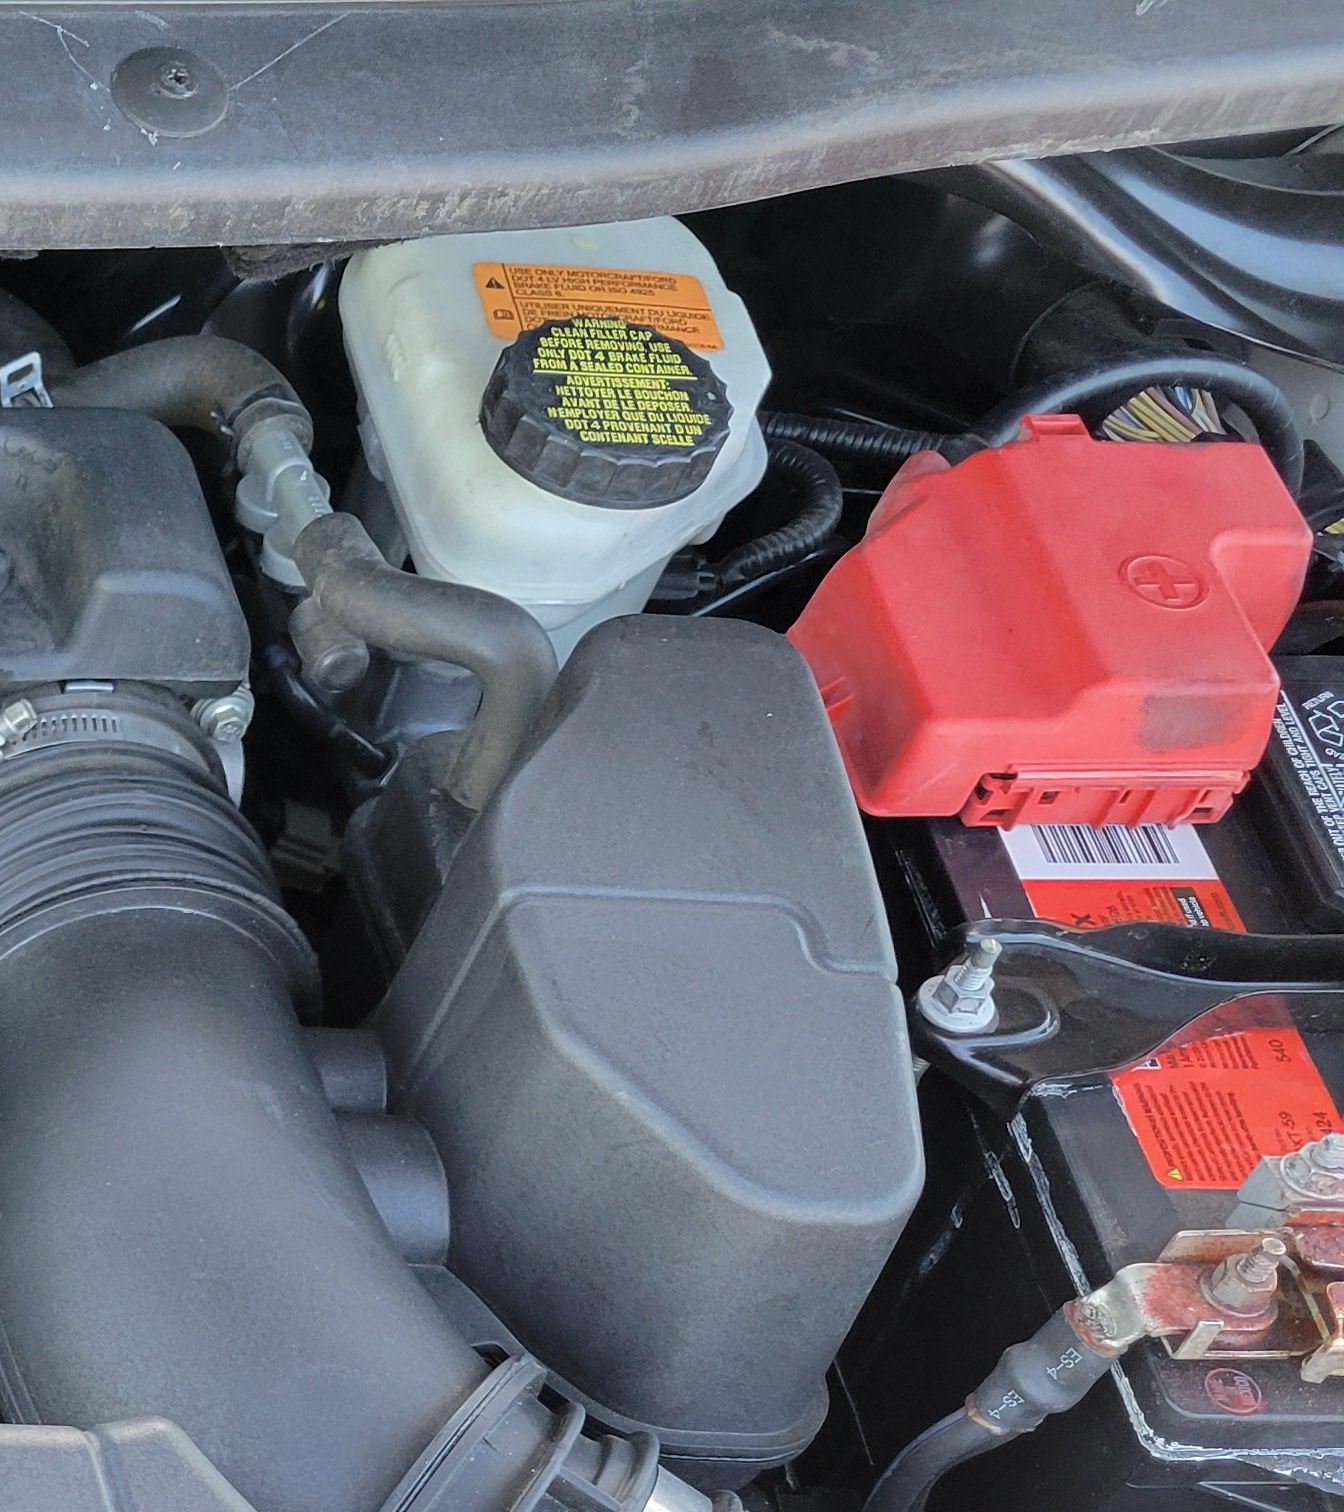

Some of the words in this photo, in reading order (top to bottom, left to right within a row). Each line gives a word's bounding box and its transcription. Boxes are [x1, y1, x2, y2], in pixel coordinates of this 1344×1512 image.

[509, 267, 531, 275] USE
[535, 268, 564, 277] ONLY
[566, 270, 677, 284] MOTORCRAFT/FORD
[511, 275, 535, 283] DOT
[562, 277, 591, 286] HIGH
[593, 279, 678, 292] PERFORMANCE
[513, 282, 551, 290] BRAKE
[608, 286, 628, 295] ISO
[515, 289, 553, 297] CLASS
[519, 301, 570, 311] UTILISER
[572, 303, 646, 316] UNIQUEMENT
[648, 309, 664, 317] DU
[666, 310, 710, 321] LIQUIDE
[522, 308, 538, 316] DE
[540, 309, 572, 317] FREIN
[550, 327, 588, 338] CLEAN
[589, 328, 628, 340] FILLER
[629, 329, 653, 341] CAP
[539, 337, 585, 349] BEFORE
[648, 342, 672, 353] USE
[537, 347, 565, 359] ONLY
[568, 349, 592, 361] DOT
[594, 351, 605, 361] 4
[607, 351, 648, 363] BRAKE
[648, 352, 682, 364] FLUID
[532, 358, 568, 370] FROM
[569, 360, 579, 371] A
[579, 361, 624, 373] SEALED
[566, 375, 671, 390] ADVERTISSEMENT:
[555, 385, 616, 399] NETTOYER
[616, 388, 633, 399] LE
[633, 389, 690, 401] BOUCHON
[562, 396, 602, 409] AVANT
[602, 399, 620, 410] DE
[620, 400, 637, 410] LE
[564, 419, 589, 430] DOT
[590, 420, 601, 430] 4
[602, 420, 672, 434] PROVENANT
[621, 411, 647, 422] QUE
[647, 412, 665, 422] DU
[665, 413, 712, 425] LIQUIDE
[579, 430, 649, 444] CONTENANT
[651, 433, 696, 447] SCELLE
[1272, 718, 1299, 756] CHILDREN
[1288, 726, 1305, 744] AND
[1296, 744, 1317, 768] TIGHT
[1297, 770, 1320, 796] REACH
[1311, 797, 1329, 815] THE
[1268, 1038, 1292, 1063] 540
[1045, 1346, 1083, 1381] ES-4
[987, 1389, 1025, 1420] ES-4
